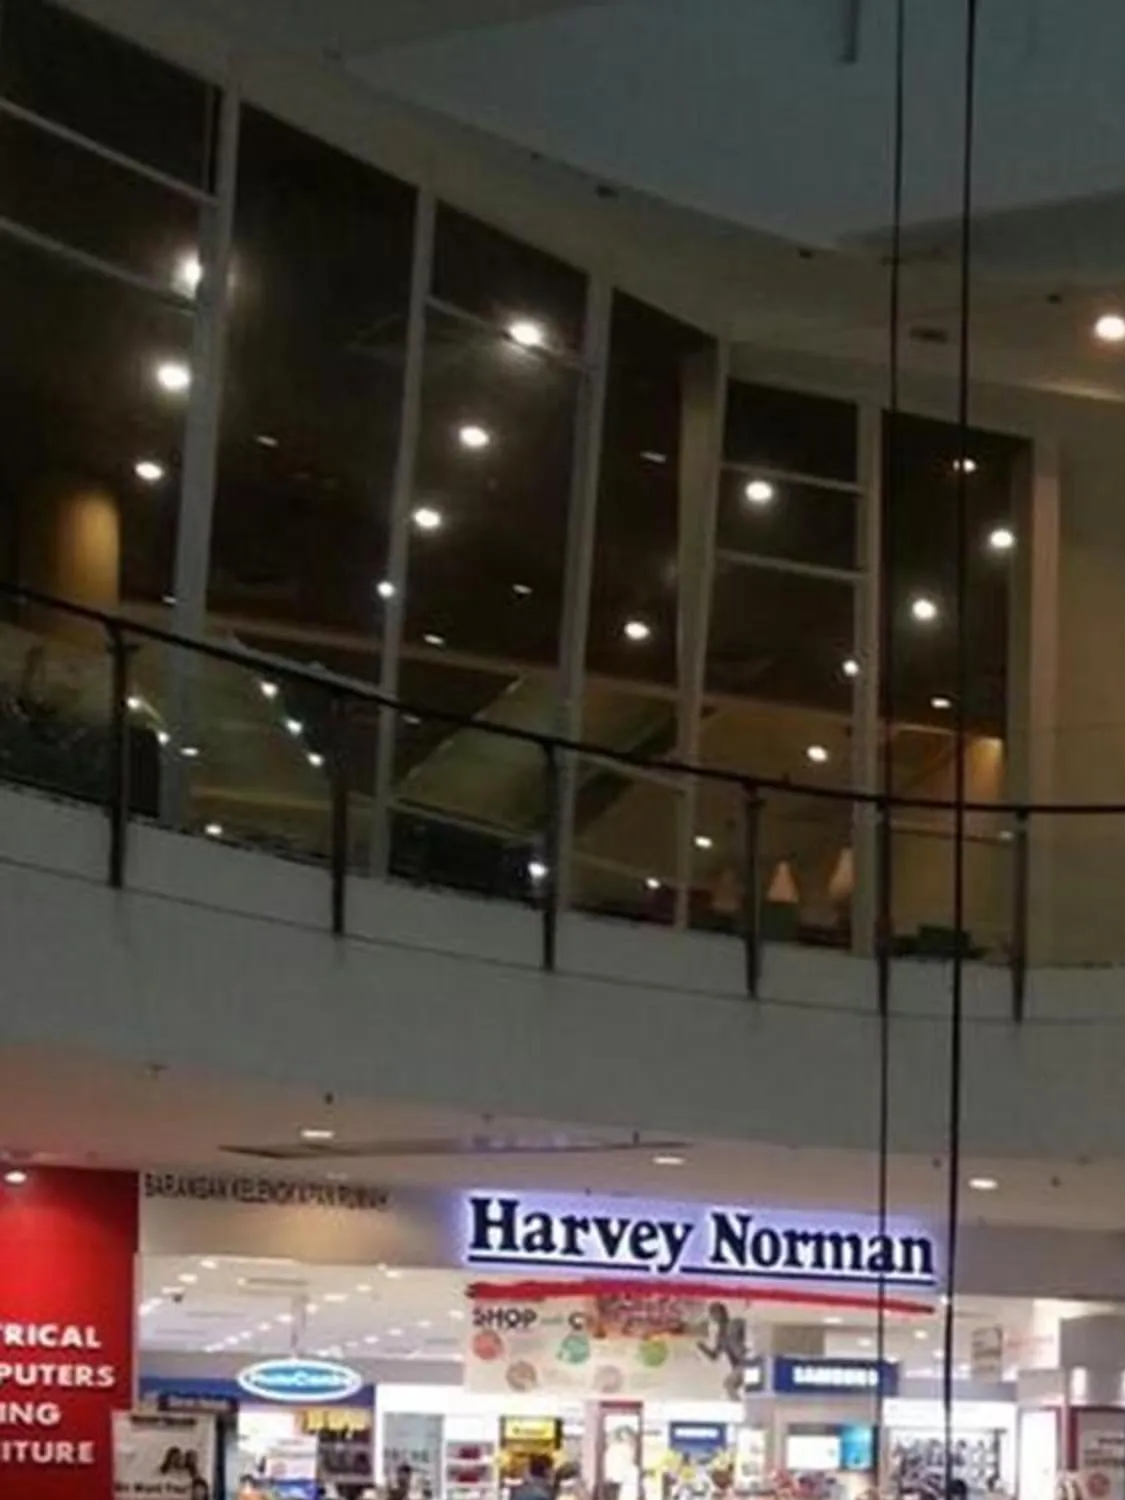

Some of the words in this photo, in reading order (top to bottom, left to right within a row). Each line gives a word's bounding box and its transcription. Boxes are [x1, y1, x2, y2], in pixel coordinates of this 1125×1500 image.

[469, 1197, 694, 1273] Harvey
[710, 1211, 934, 1274] Norman
[472, 1307, 537, 1329] SHOP
